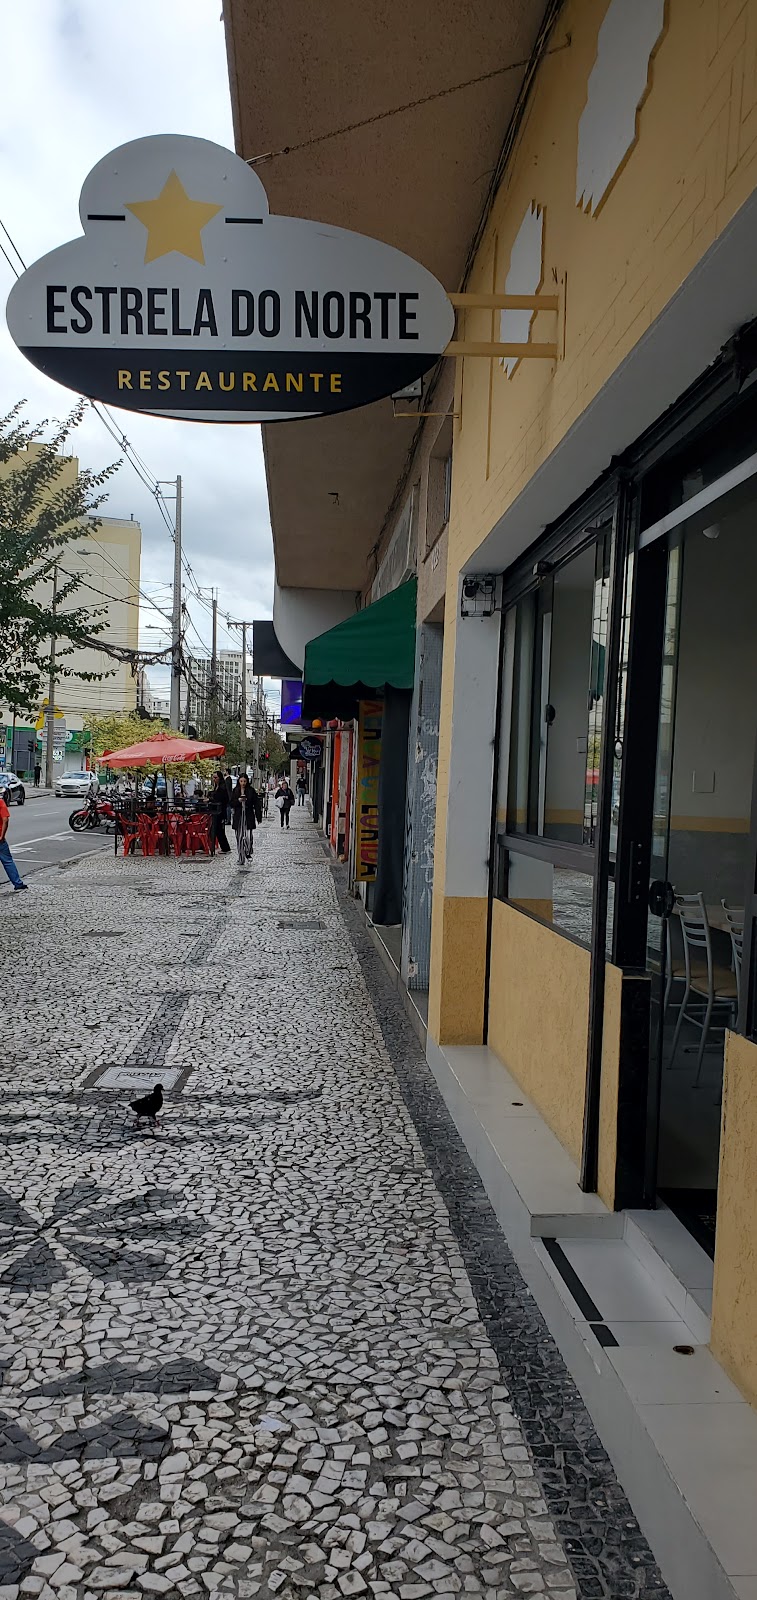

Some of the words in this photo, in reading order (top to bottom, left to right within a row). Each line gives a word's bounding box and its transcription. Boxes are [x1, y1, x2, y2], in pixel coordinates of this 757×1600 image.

[46, 285, 218, 337] ESTRELA
[232, 289, 281, 338] DO
[295, 290, 420, 340] NORTE
[117, 369, 343, 393] RESTAURANTE
